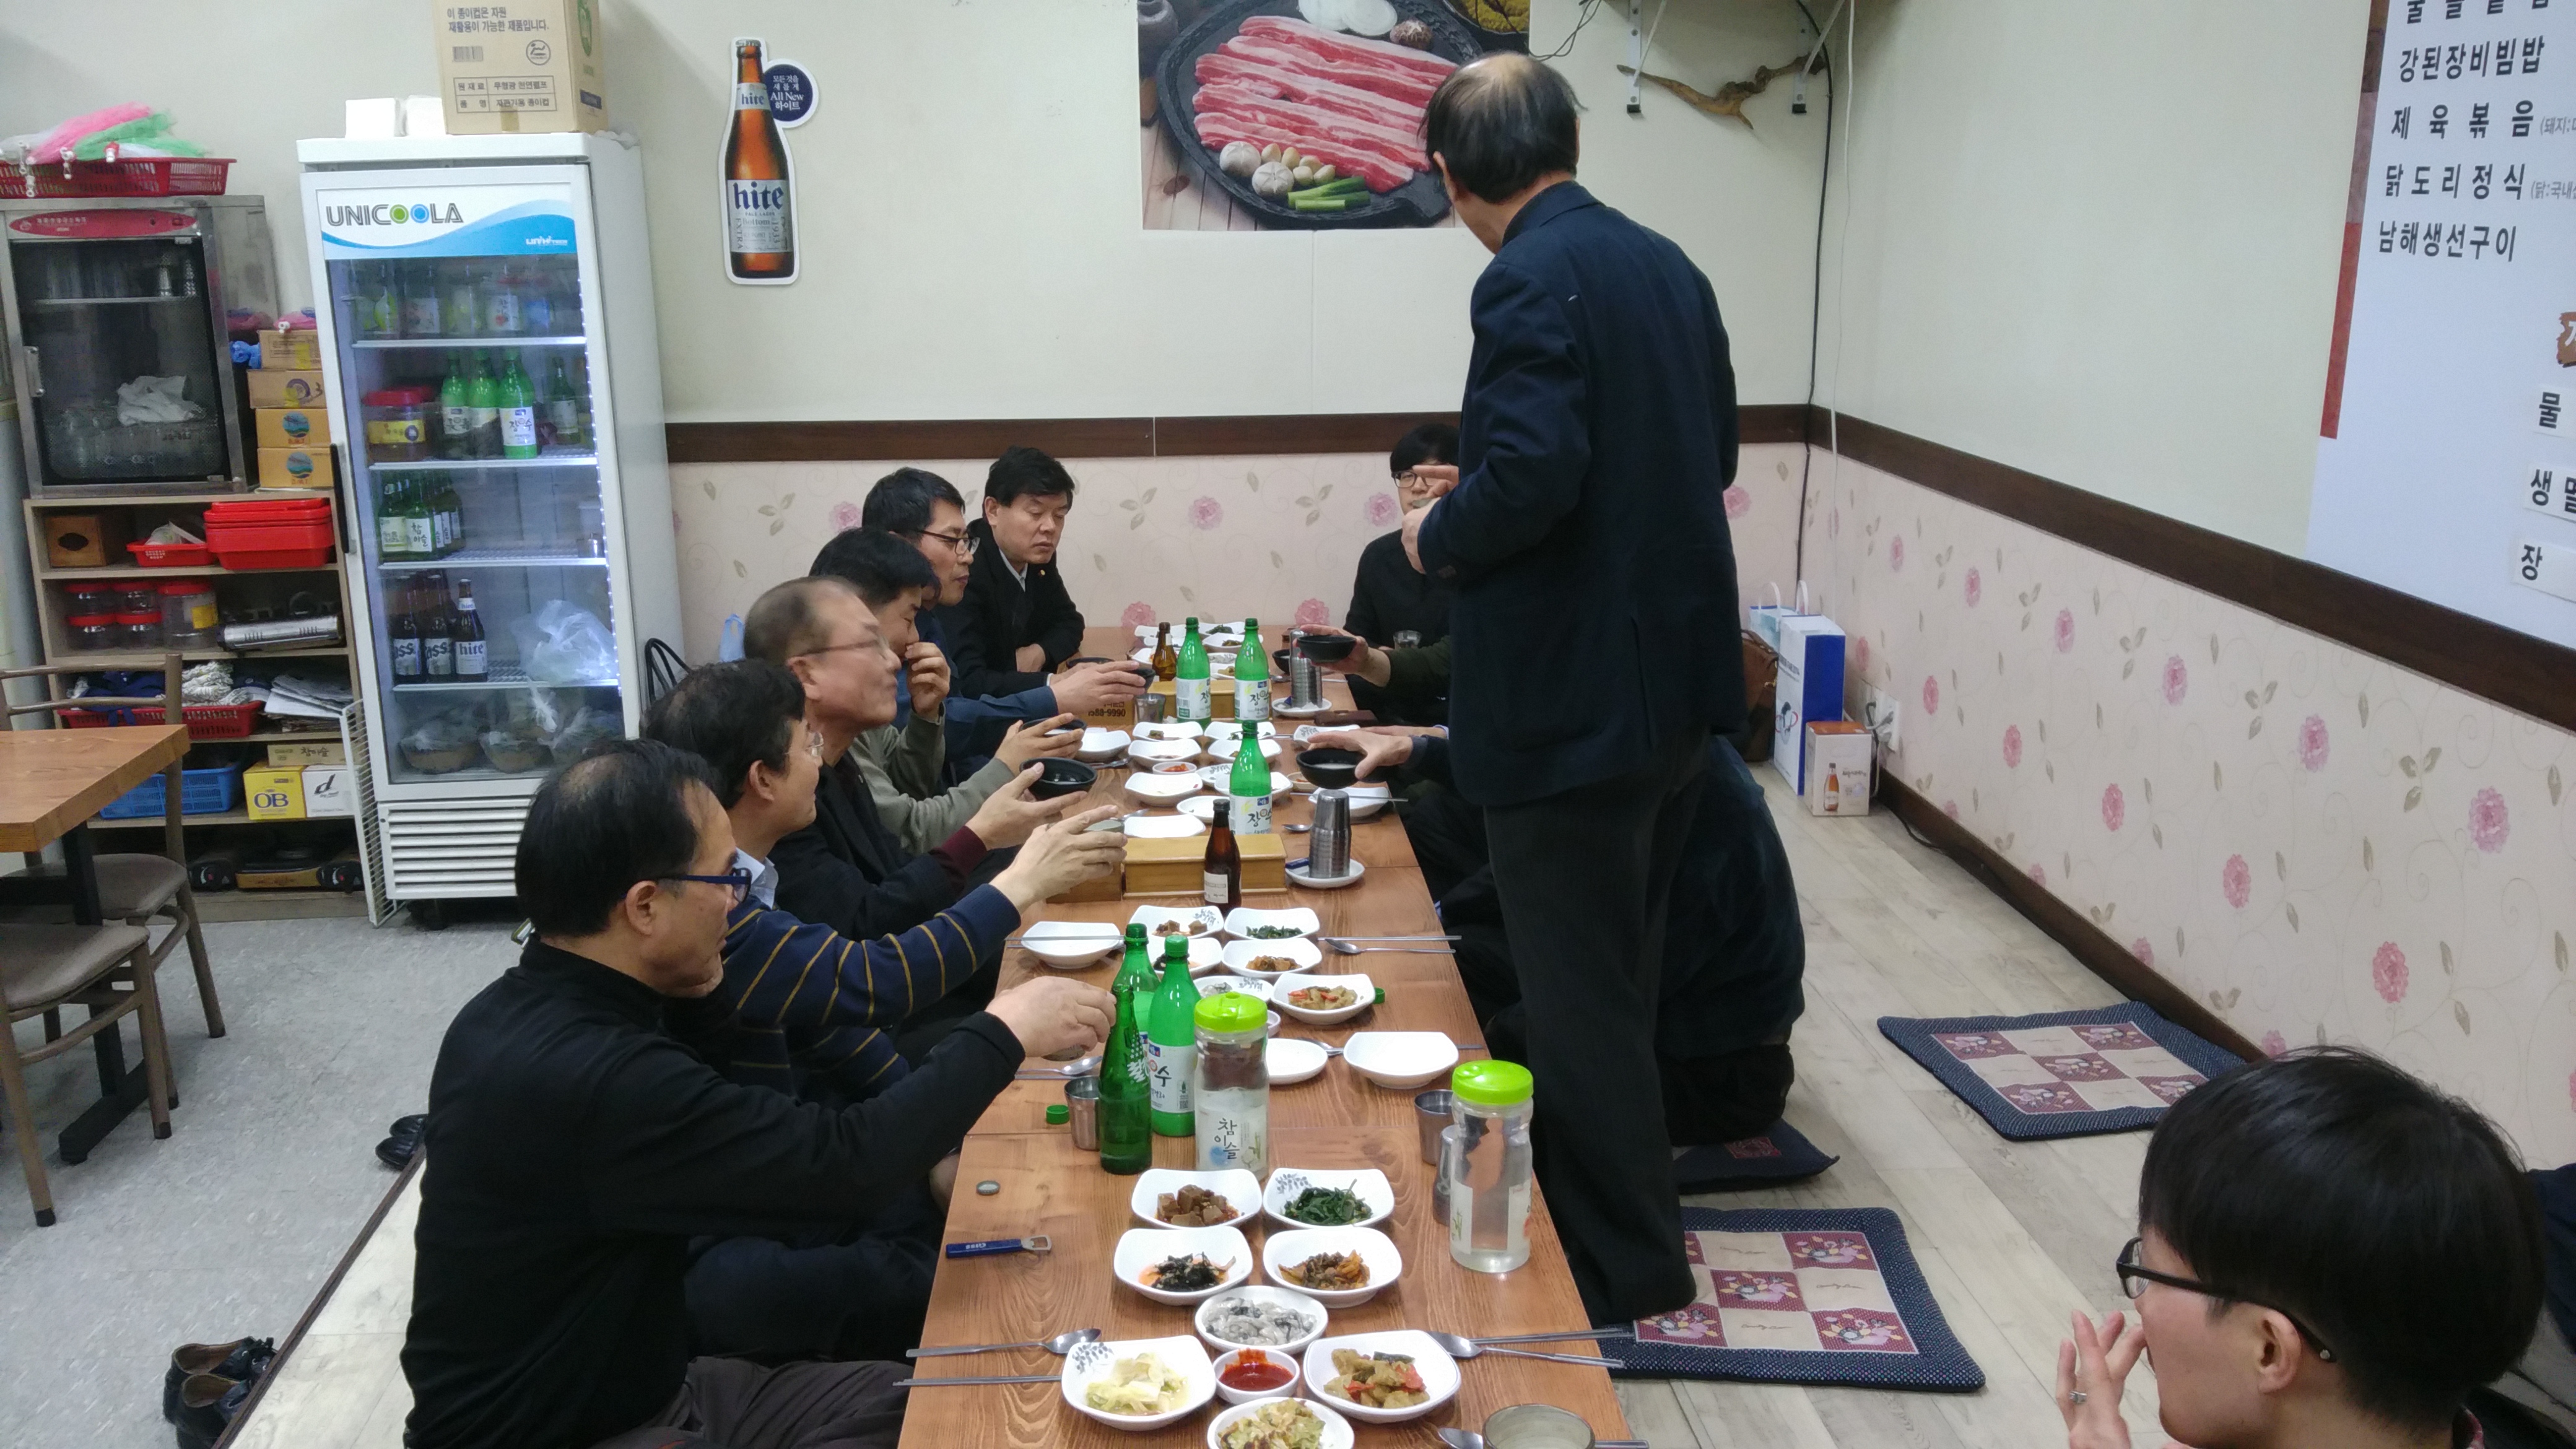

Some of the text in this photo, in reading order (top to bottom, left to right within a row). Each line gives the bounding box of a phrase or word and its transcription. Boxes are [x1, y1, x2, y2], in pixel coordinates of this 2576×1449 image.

[446, 6, 507, 20] 이 종이컵은 자원
[448, 19, 549, 33] 재활용이 가능한 제품입니다.
[2399, 35, 2545, 83] 강된장비빔밥
[528, 98, 549, 107] 종이컵
[741, 92, 765, 105] hite
[770, 92, 804, 101] All New
[774, 101, 801, 111] 하이트
[2385, 163, 2526, 201] 닭도리정식
[733, 181, 785, 211] hite
[325, 202, 464, 227] UNICOOLA
[2378, 220, 2517, 263] 남해생선구이
[459, 642, 484, 656] hite
[254, 793, 289, 809] OB
